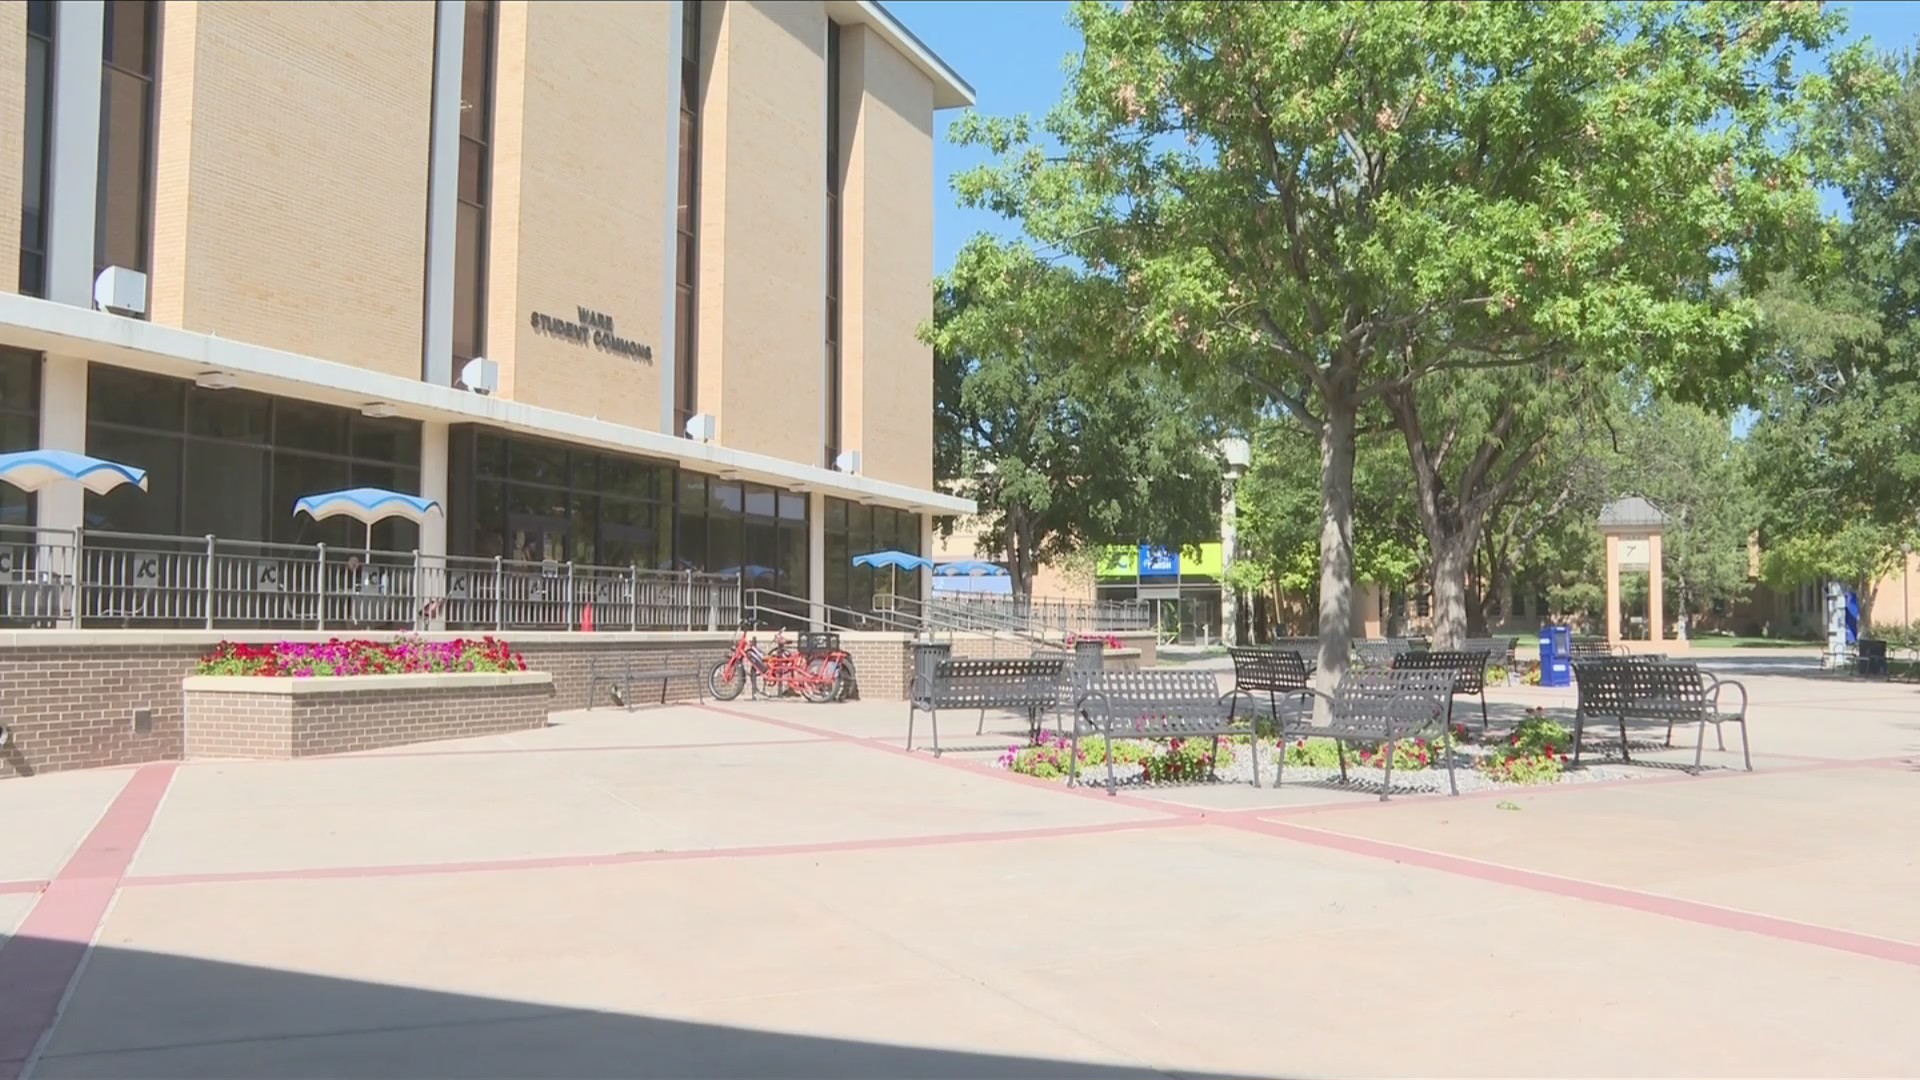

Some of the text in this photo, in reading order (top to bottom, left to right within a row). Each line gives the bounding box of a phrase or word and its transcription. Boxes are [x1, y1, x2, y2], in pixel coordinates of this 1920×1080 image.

[577, 305, 614, 331] WARE
[530, 311, 653, 362] STUDENT COMMONS
[137, 559, 157, 578] AC
[260, 565, 277, 584] AC
